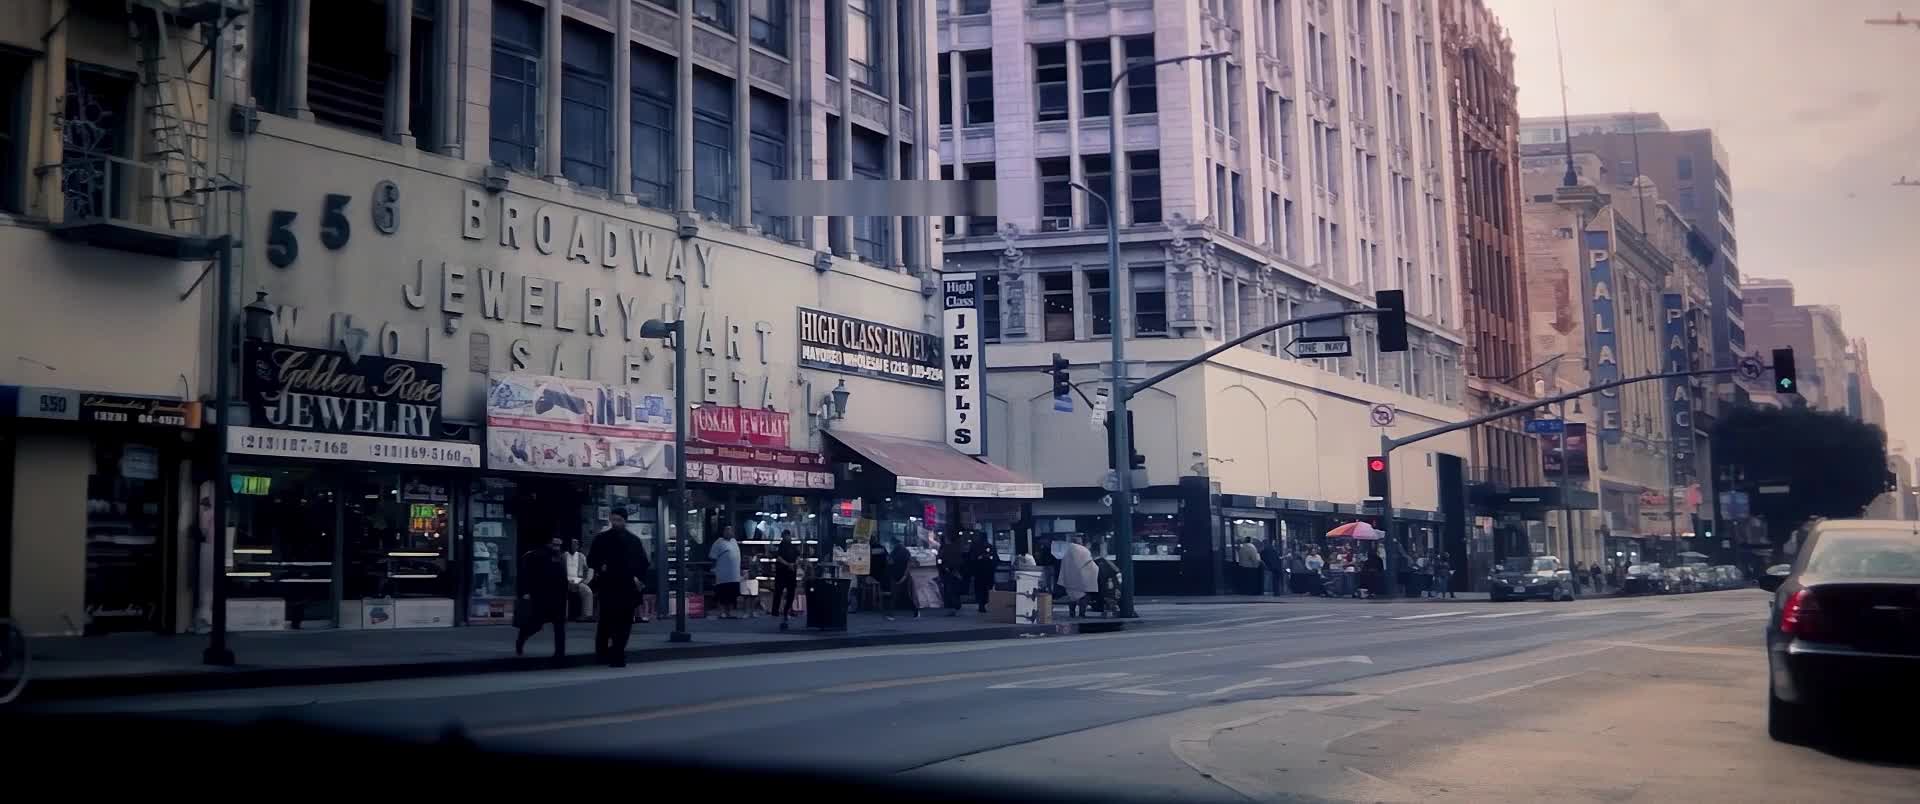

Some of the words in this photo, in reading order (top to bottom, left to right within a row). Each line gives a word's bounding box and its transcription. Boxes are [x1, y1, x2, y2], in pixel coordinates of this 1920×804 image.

[266, 180, 400, 269] 556
[463, 189, 717, 288] BROADWAY
[402, 258, 638, 342] JEWELRY
[946, 281, 974, 295] High
[946, 296, 974, 307] Class
[801, 311, 838, 345] HIGH
[842, 320, 883, 353] CLASS
[1299, 343, 1317, 353] ONE
[1589, 249, 1619, 429] PALACE
[272, 348, 366, 395] Golden
[372, 364, 441, 402] Rose
[952, 314, 973, 444] JEWEL'S
[261, 391, 438, 437] JEWELRY
